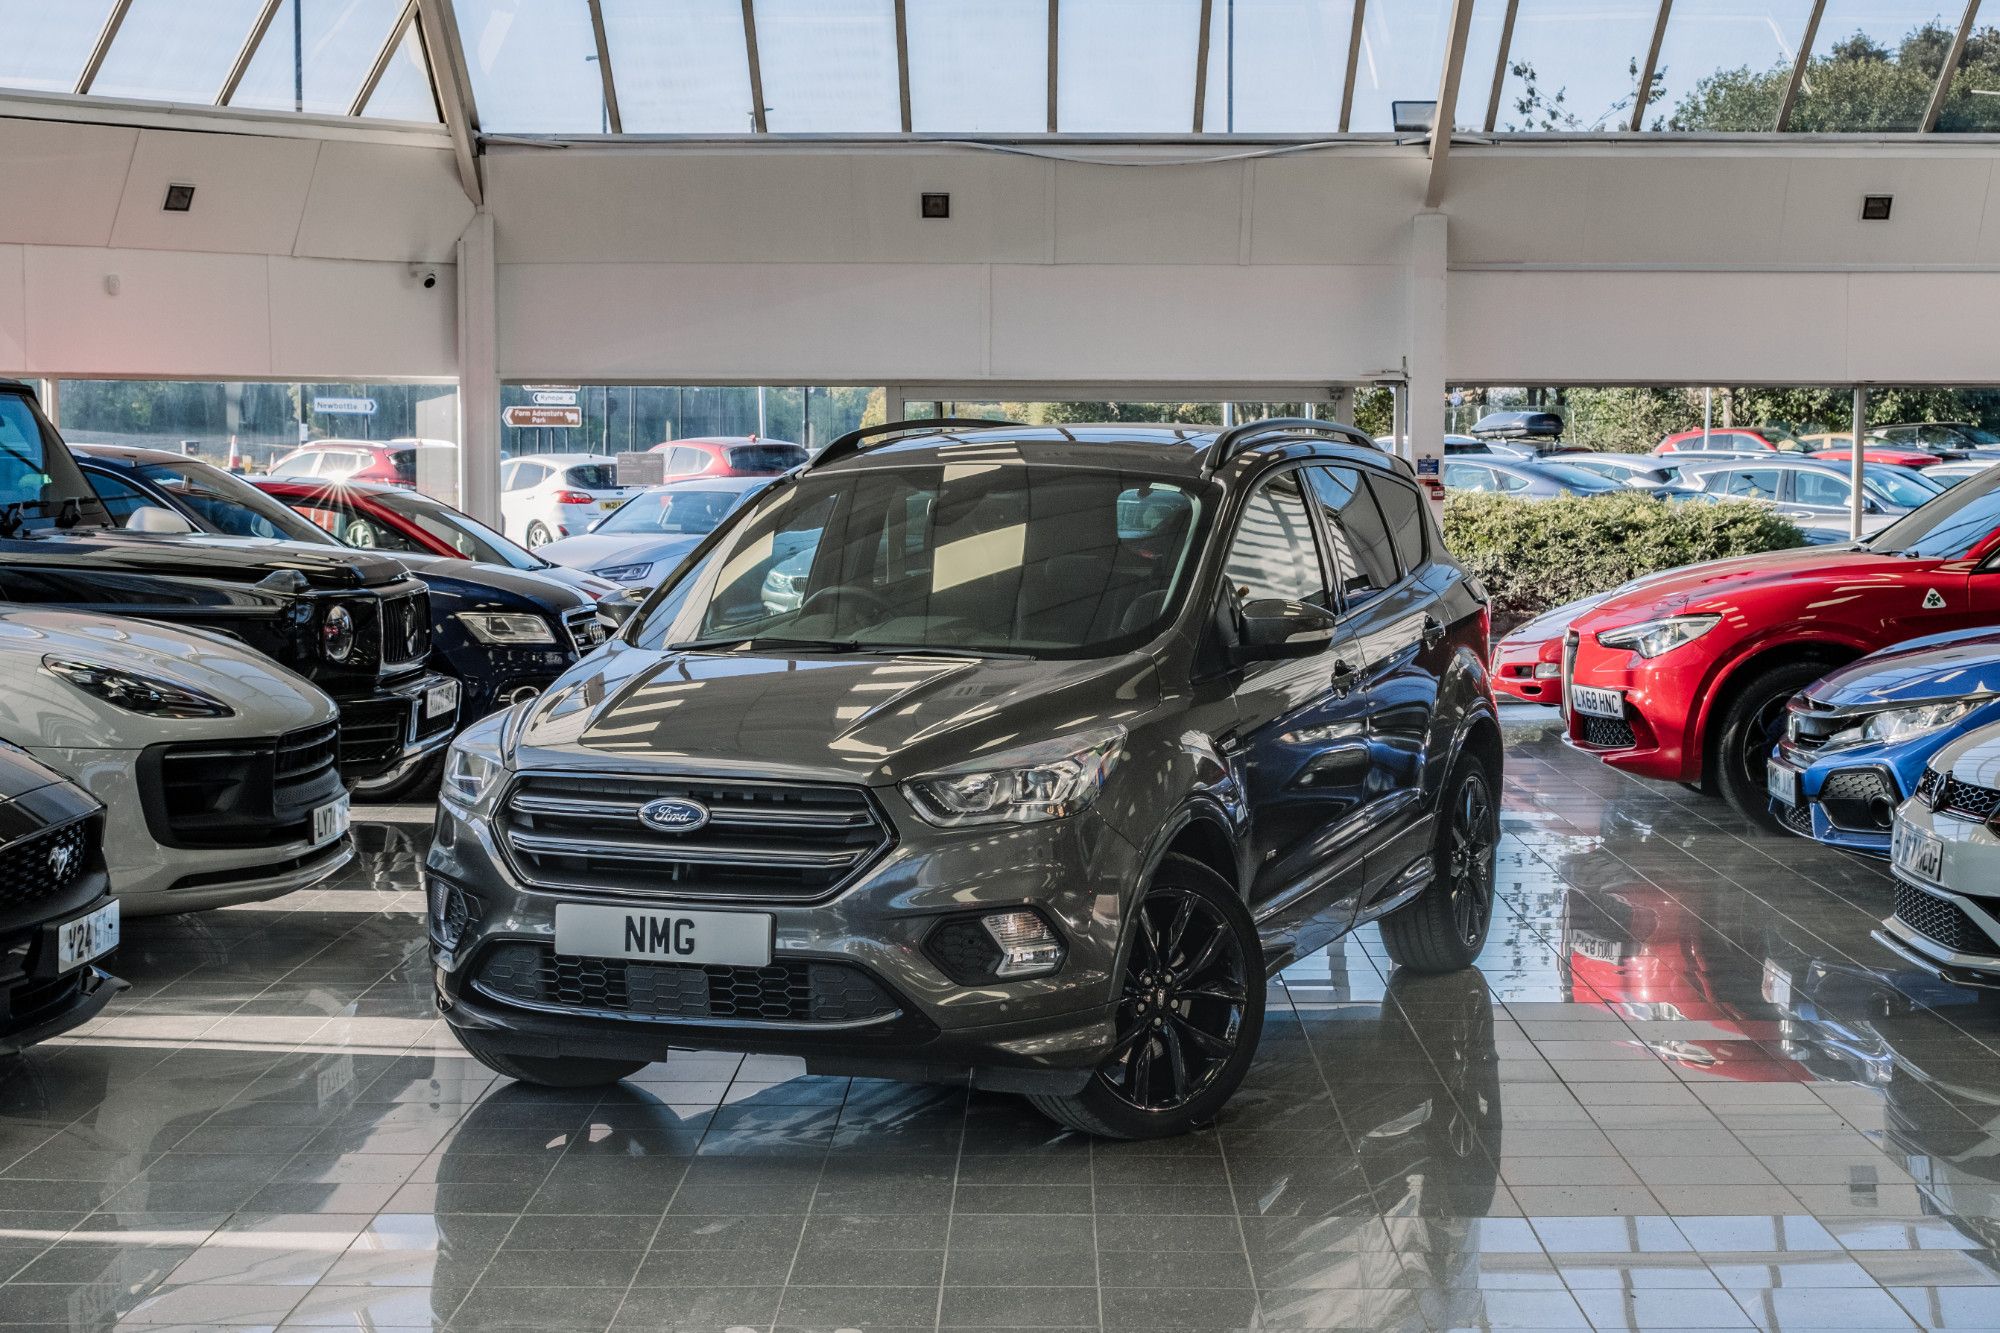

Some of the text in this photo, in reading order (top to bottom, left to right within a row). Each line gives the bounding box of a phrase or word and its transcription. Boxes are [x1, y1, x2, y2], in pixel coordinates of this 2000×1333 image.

[317, 401, 358, 410] Newbottle
[514, 409, 564, 417] Farm Adventure
[1575, 688, 1619, 714] LX68 HNC
[653, 804, 695, 823] Ford
[624, 915, 696, 955] NMG
